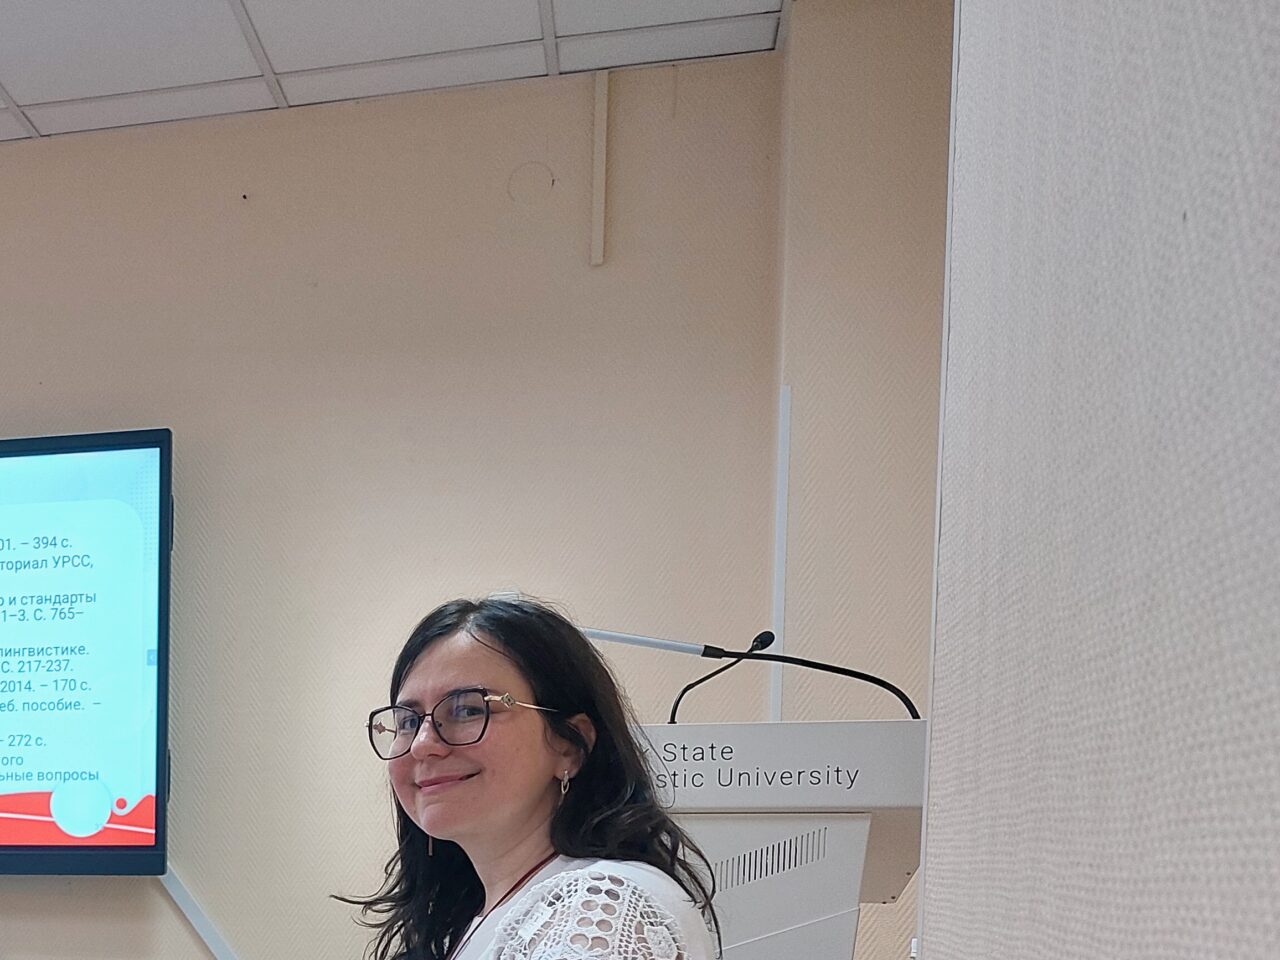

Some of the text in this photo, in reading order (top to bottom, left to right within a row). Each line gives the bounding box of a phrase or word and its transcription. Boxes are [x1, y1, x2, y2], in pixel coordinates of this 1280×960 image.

[32, 536, 58, 550] 394
[51, 555, 93, 571] УРСС,
[20, 593, 96, 608] стандарты
[16, 660, 74, 673] 217-237.
[0, 680, 35, 692] 2014.
[52, 679, 77, 691] 170
[22, 698, 85, 711] пособие.
[7, 734, 32, 746] 272
[662, 742, 734, 762] State
[36, 770, 99, 783] вопросы
[655, 764, 861, 790] stic University
